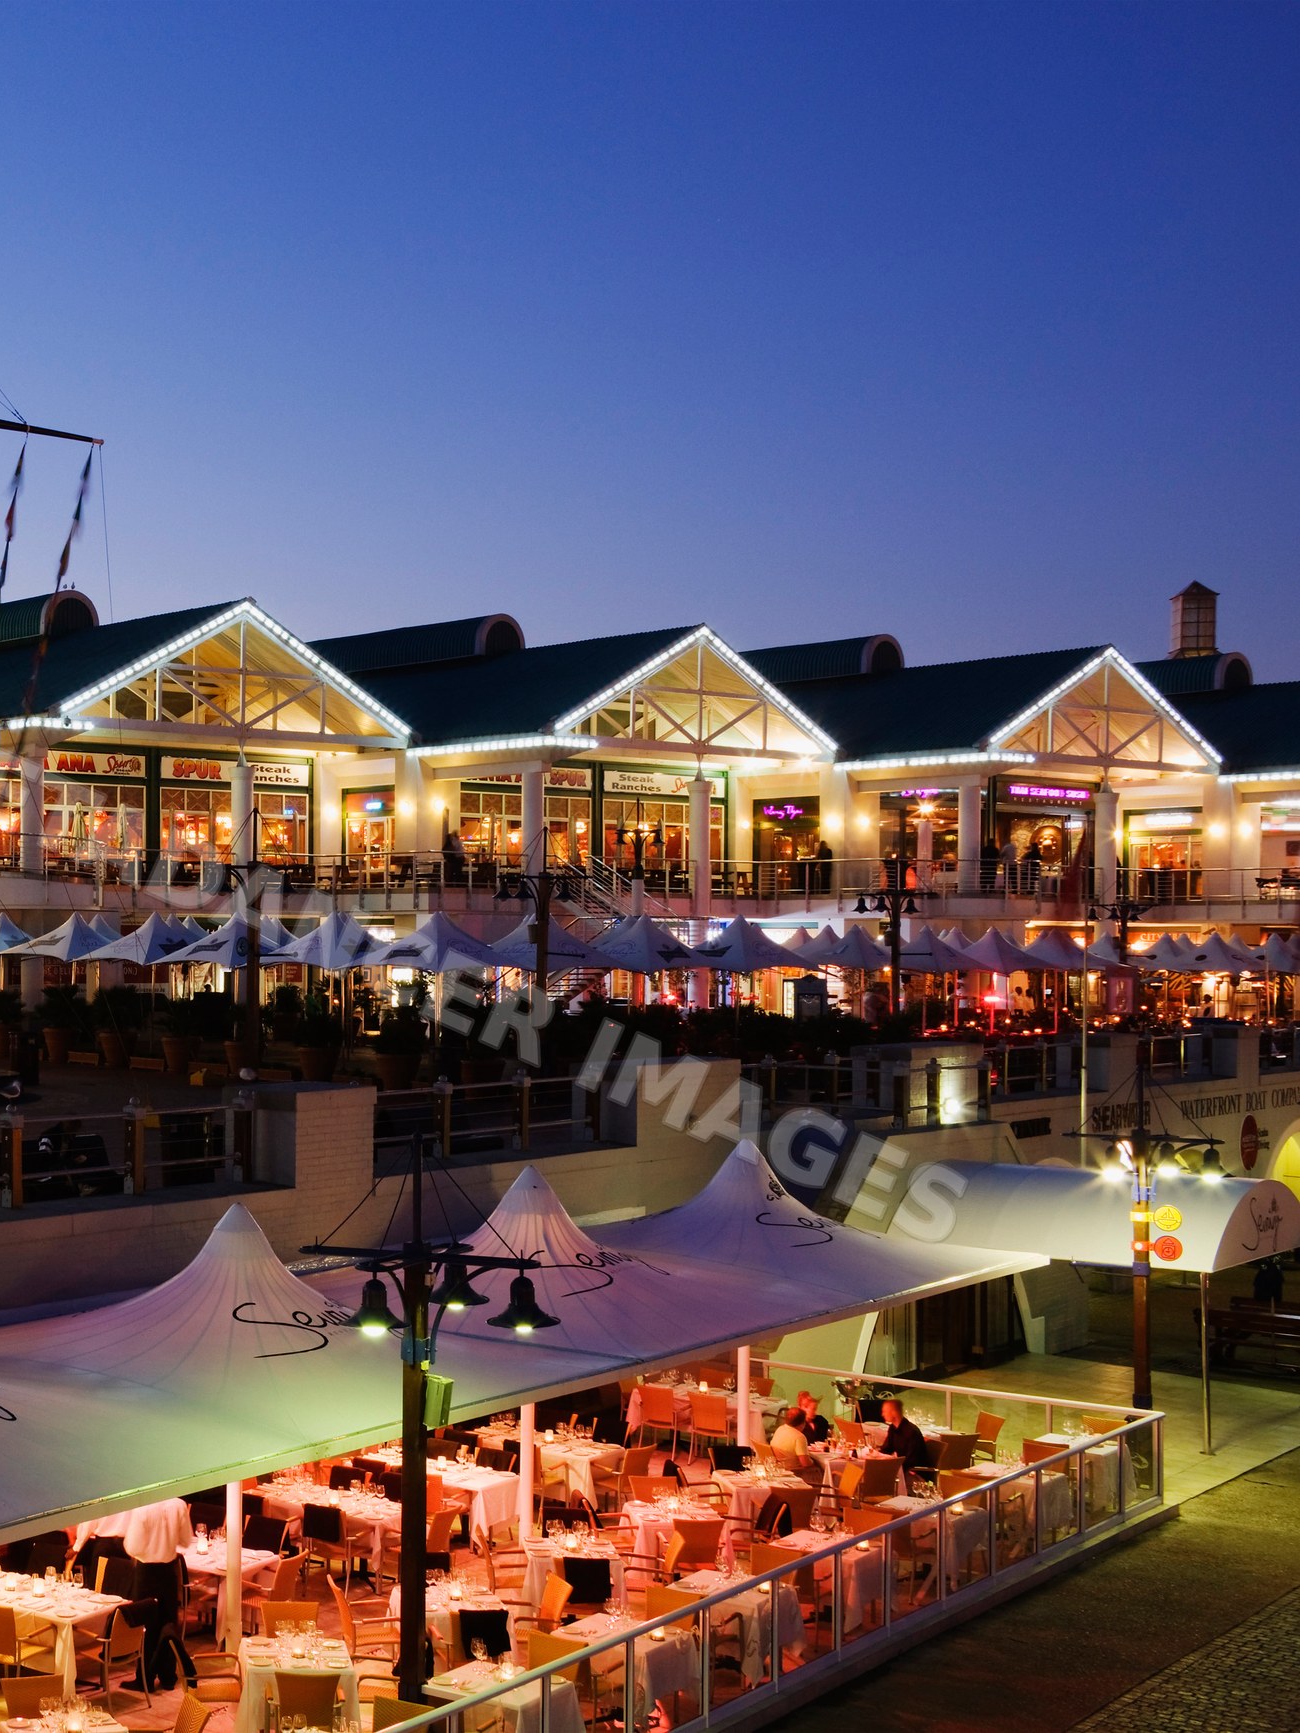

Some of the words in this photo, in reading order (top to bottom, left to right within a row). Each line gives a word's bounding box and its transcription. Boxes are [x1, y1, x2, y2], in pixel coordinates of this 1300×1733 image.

[172, 759, 222, 780] SPUR
[252, 764, 291, 774] Steak
[551, 769, 586, 787] SPUR
[618, 773, 654, 783] Steak
[612, 782, 662, 792] Ranches
[1180, 1094, 1242, 1120] WATERFRONT
[1245, 1091, 1267, 1112] BOAT
